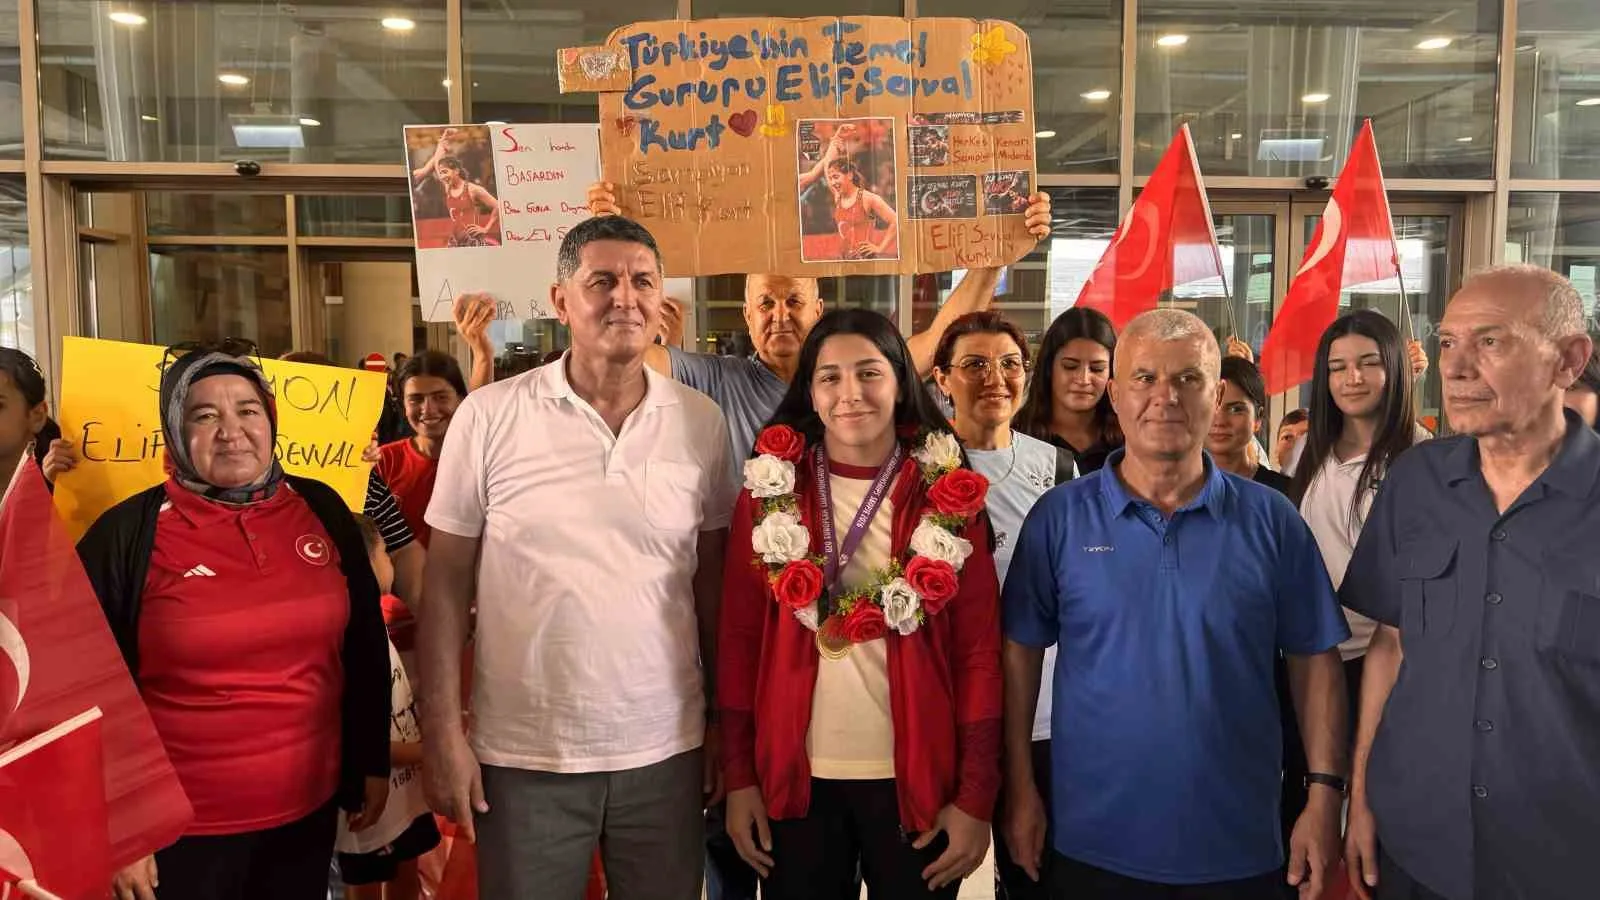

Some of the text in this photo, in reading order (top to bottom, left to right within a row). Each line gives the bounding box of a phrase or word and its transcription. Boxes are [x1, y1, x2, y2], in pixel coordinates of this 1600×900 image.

[822, 21, 928, 68] Temel
[624, 74, 766, 110] Gururu
[776, 62, 855, 105] Elif
[639, 114, 726, 155] Kurt
[636, 190, 687, 219] Elif
[930, 224, 968, 250] Elif
